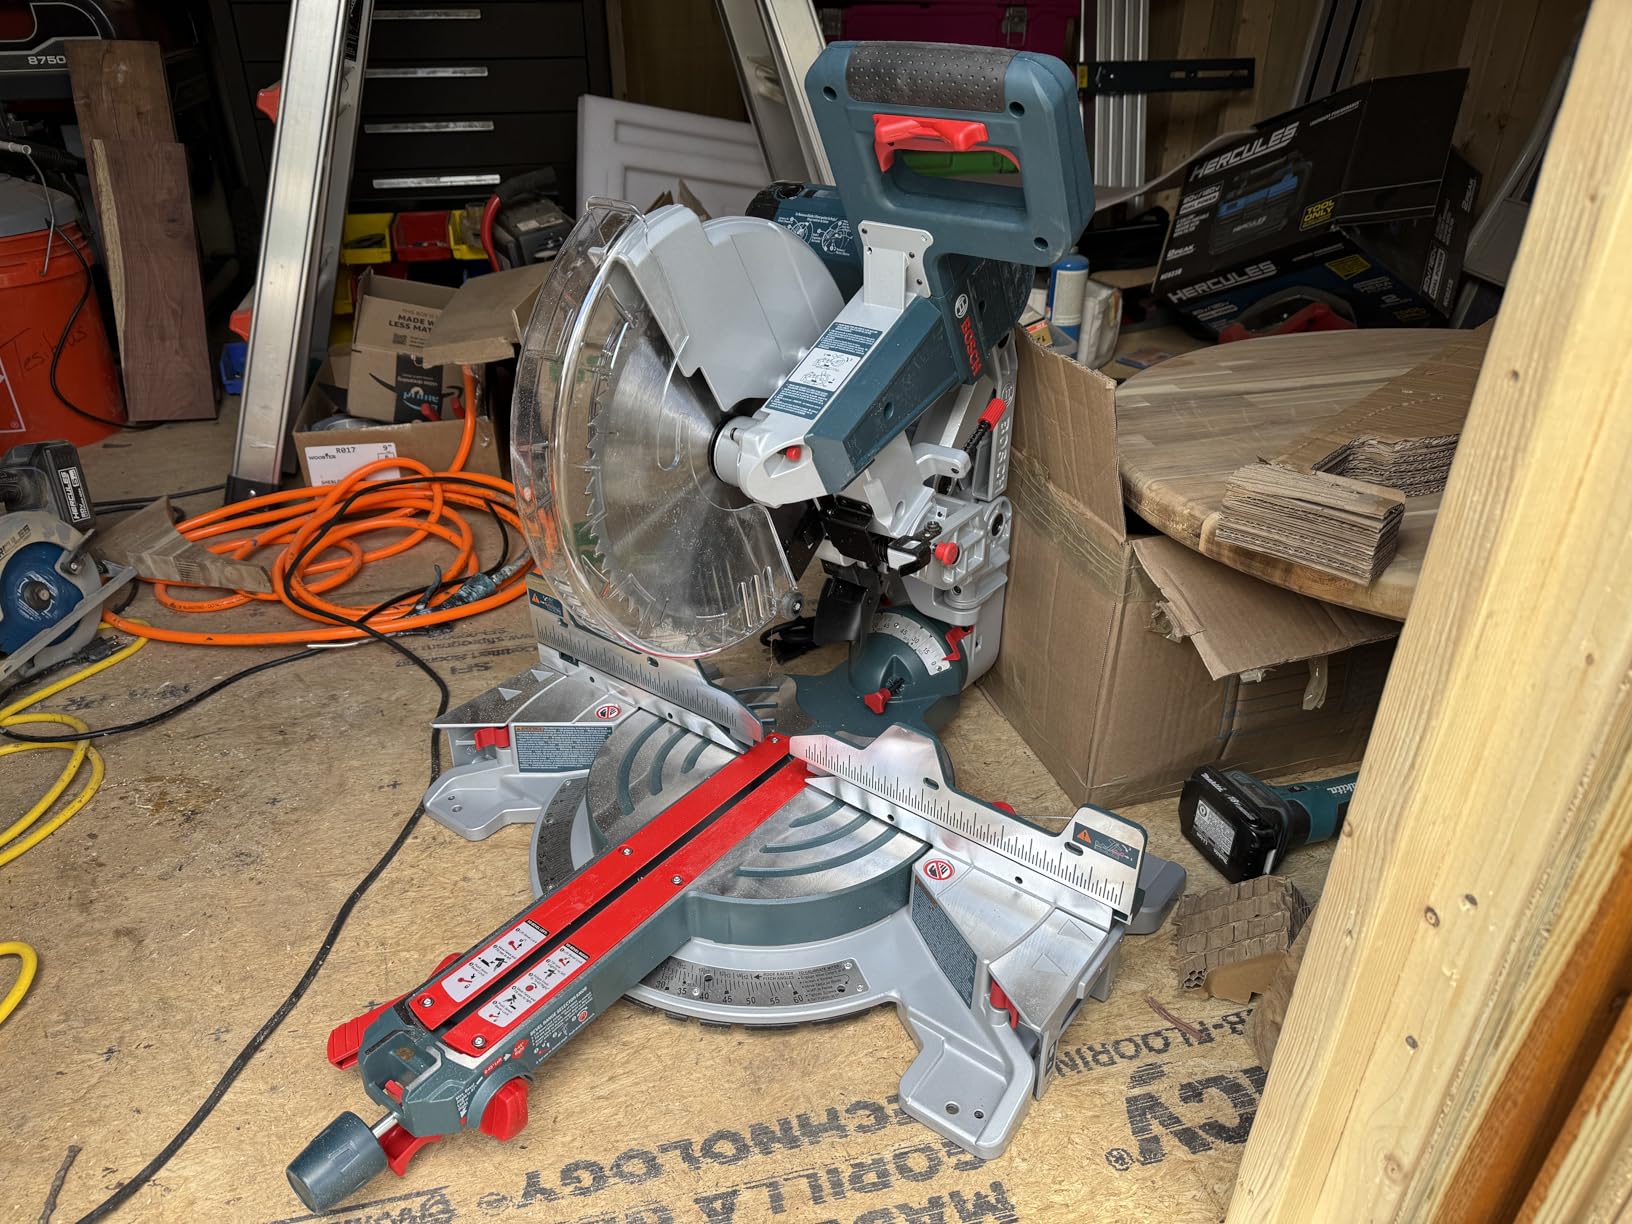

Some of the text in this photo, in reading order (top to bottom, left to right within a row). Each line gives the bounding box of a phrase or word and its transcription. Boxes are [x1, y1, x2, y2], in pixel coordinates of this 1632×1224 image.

[27, 55, 66, 65] 8750
[1188, 121, 1299, 182] HERCULES
[1306, 200, 1335, 214] TOOL
[1303, 207, 1334, 222] ONLY
[1169, 260, 1278, 304] HERCULES
[388, 320, 411, 330] LESS
[398, 314, 425, 324] MADE
[961, 315, 982, 378] BOSCH
[308, 452, 337, 460] WOOSTER
[336, 446, 356, 454] R017
[60, 472, 80, 519] HERCULES
[922, 647, 931, 655] 15
[1326, 782, 1356, 794] akita
[678, 987, 687, 995] 35
[699, 992, 709, 1000] 40
[722, 995, 733, 1003] 45
[746, 996, 756, 1005] 50
[769, 996, 780, 1005] 55
[793, 994, 803, 1003] 60
